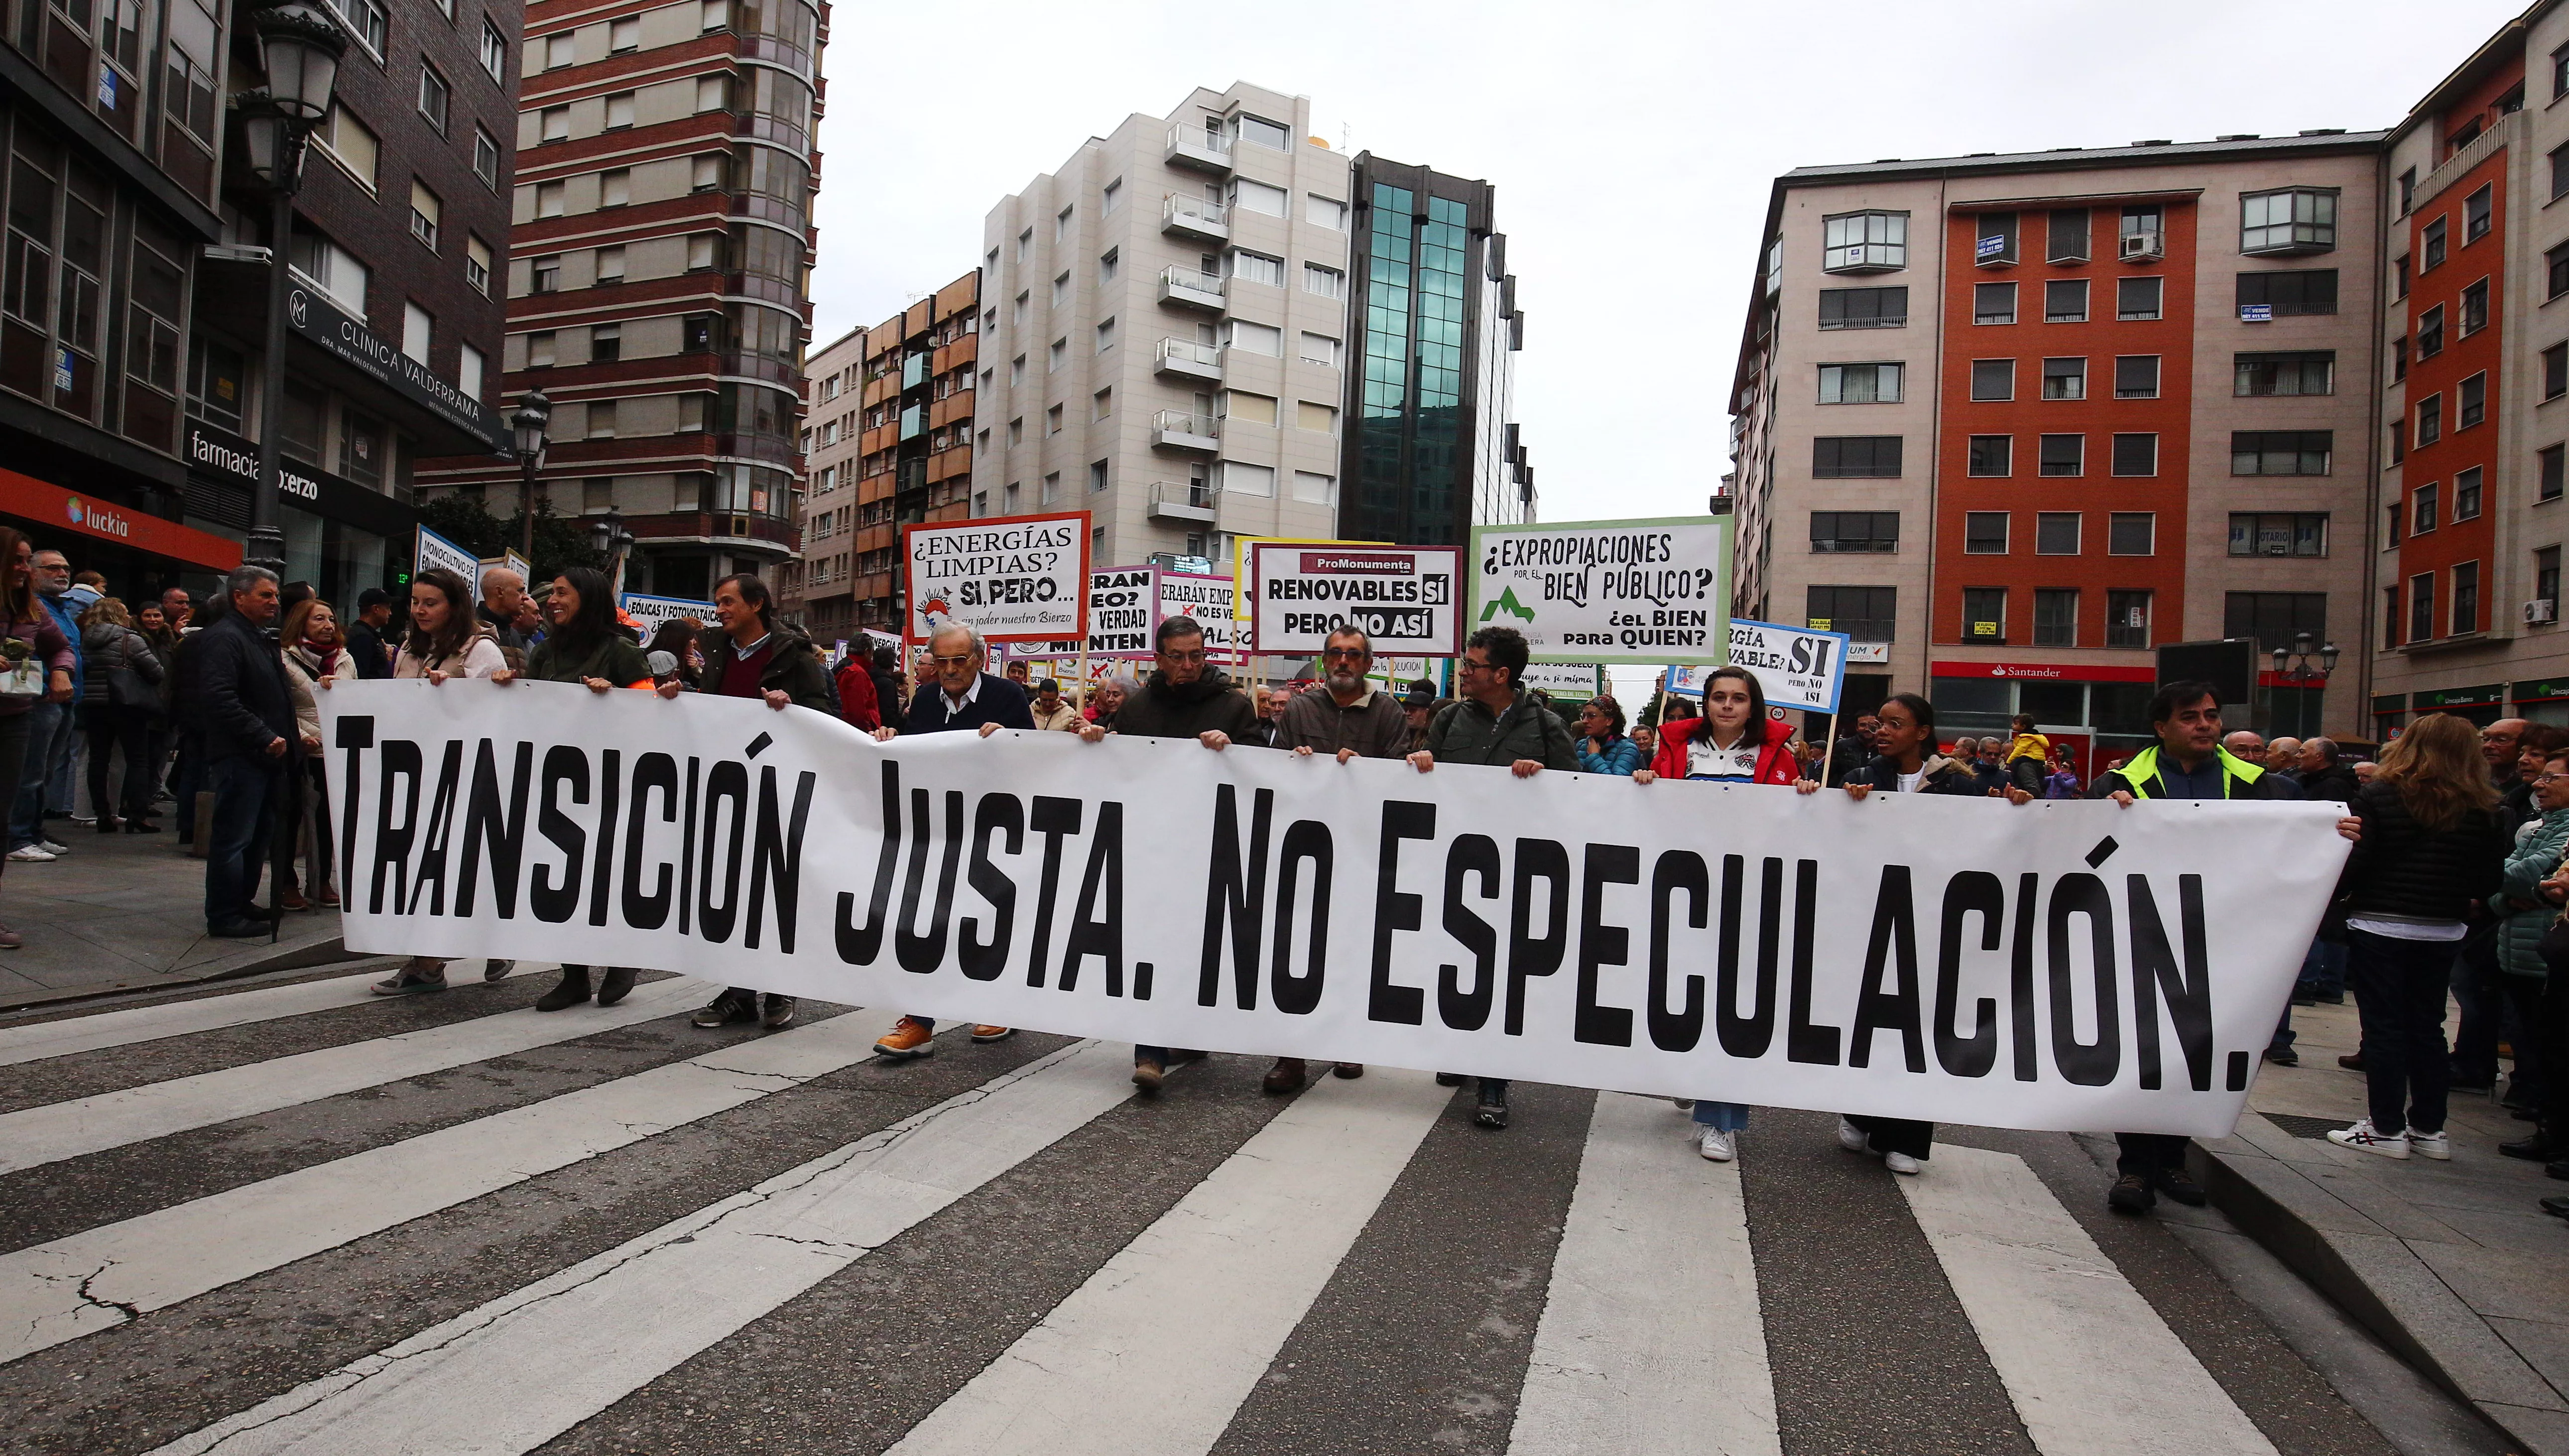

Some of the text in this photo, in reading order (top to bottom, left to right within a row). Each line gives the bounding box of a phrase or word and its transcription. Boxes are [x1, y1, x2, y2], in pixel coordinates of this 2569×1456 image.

[321, 336, 388, 381] DRA. MAR VALDERRAMA
[341, 321, 480, 422] CLINICA VALDERRAMA
[86, 505, 128, 537] luckia
[914, 525, 1071, 561] ¿ENERGÍAS
[424, 540, 466, 573] MONOCULTIVO
[466, 564, 474, 577] DE
[926, 552, 1058, 578] LIMPIAS?
[1317, 558, 1411, 570] ProMonumenta
[1483, 534, 1672, 575] ¿EXPROPIACIONES
[1269, 575, 1447, 603] RENOVABLES SÍ
[1514, 570, 1530, 580] POR
[1531, 570, 1544, 580] EL
[1544, 563, 1596, 608] BIEN
[627, 599, 660, 617] ¿EÓLICAS
[662, 605, 667, 617] Y
[975, 611, 999, 626] joder
[1038, 610, 1072, 623] Bierzo
[1197, 606, 1209, 617] NO
[1211, 607, 1222, 619] ES
[1652, 610, 1707, 626] BIEN
[1099, 609, 1146, 631] VERDAD
[1284, 609, 1431, 636] PERO NO ASÍ
[1050, 633, 1146, 652] MINTEN
[1201, 626, 1252, 645] ALSO
[1620, 630, 1707, 649] QUIEN?
[1381, 662, 1387, 671] la
[1788, 636, 1832, 677] SI
[2008, 666, 2061, 677] Santander
[1788, 678, 1823, 690] PERO NO
[1803, 691, 1821, 703] ASÍ
[335, 715, 2248, 1092] TRANSICIÓN JUSTA. NO ESPECULACIÓN.
